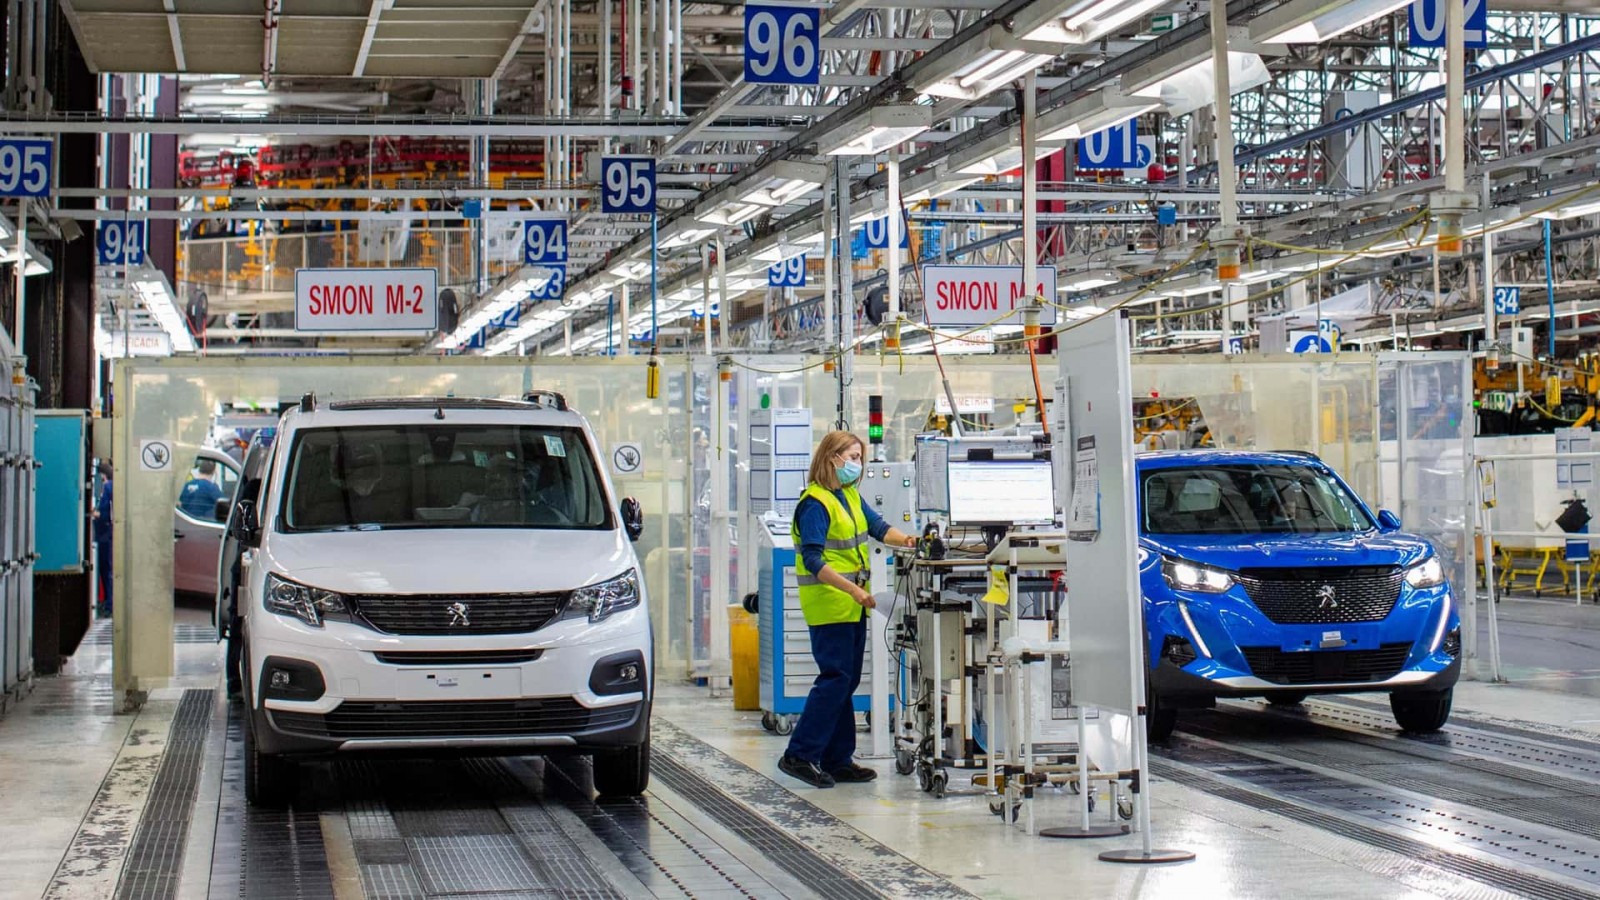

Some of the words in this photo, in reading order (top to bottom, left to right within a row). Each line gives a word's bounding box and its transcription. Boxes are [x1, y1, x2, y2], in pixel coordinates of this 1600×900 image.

[748, 12, 815, 77] 96
[1085, 119, 1131, 164] 01
[0, 145, 47, 193] 95
[606, 161, 652, 207] 95
[104, 223, 141, 261] 94
[527, 224, 566, 261] 94
[771, 255, 804, 284] 99
[309, 285, 373, 315] SMON
[386, 284, 423, 314] M-2
[936, 281, 998, 310] SMON
[1010, 282, 1045, 310] M1
[1496, 288, 1518, 313] 34
